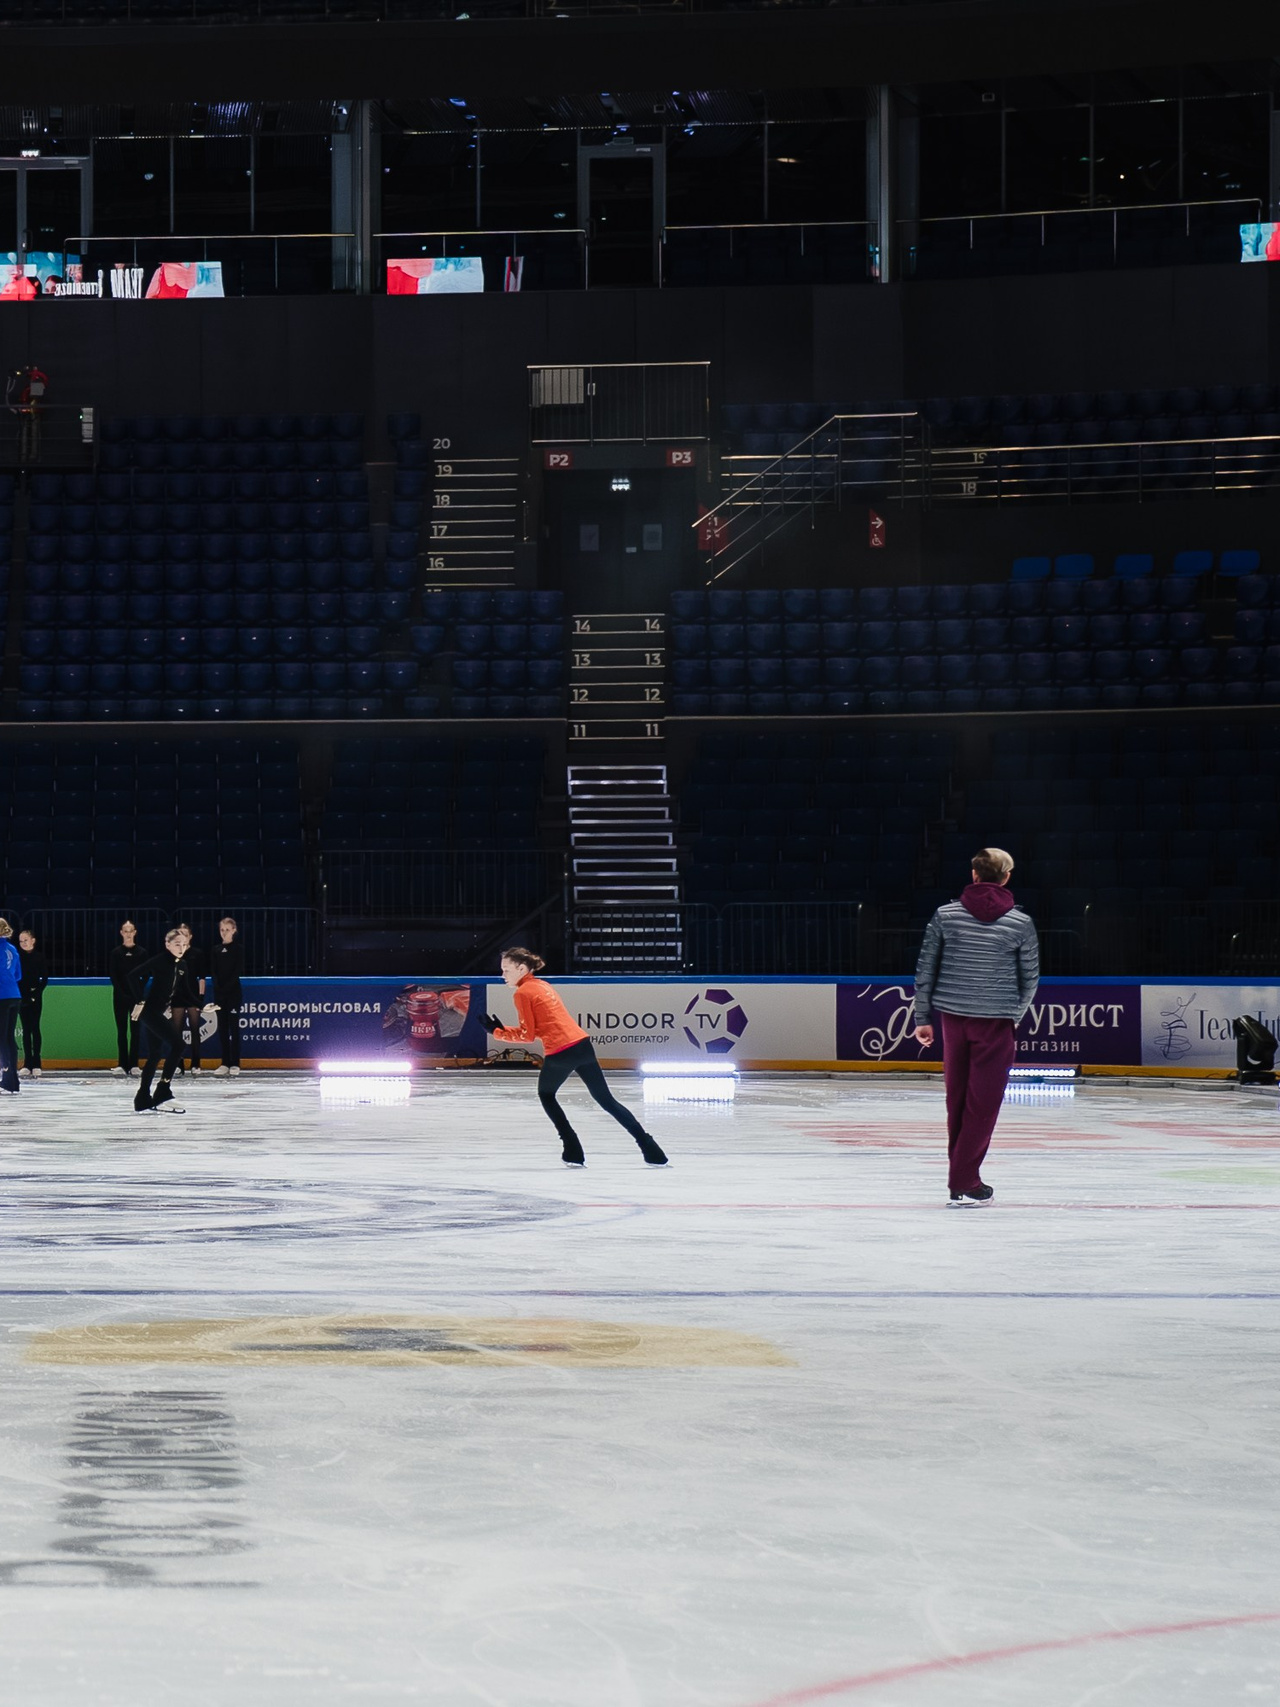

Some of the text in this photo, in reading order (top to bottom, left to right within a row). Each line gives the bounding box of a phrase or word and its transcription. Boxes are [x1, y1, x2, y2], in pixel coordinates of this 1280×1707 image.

[433, 438, 451, 449] 20
[549, 454, 569, 466] P2
[672, 451, 692, 464] P3
[437, 464, 453, 476] 19
[435, 495, 450, 507] 18
[432, 525, 447, 537] 17
[429, 557, 444, 569] 16
[575, 620, 591, 632] 14
[645, 619, 660, 631] 14
[574, 654, 591, 666] 13
[645, 653, 661, 665] 13
[573, 689, 589, 701] 12
[645, 689, 660, 701] 12
[573, 724, 586, 737] 11
[646, 723, 659, 736] 11
[239, 1002, 381, 1014] ЫБОПРОМЫСЛОВАЯ
[238, 1018, 311, 1029] ОМПАНИЯ
[577, 1013, 722, 1029] INDOOR TV
[620, 1035, 670, 1044] ОПЕРАТОР
